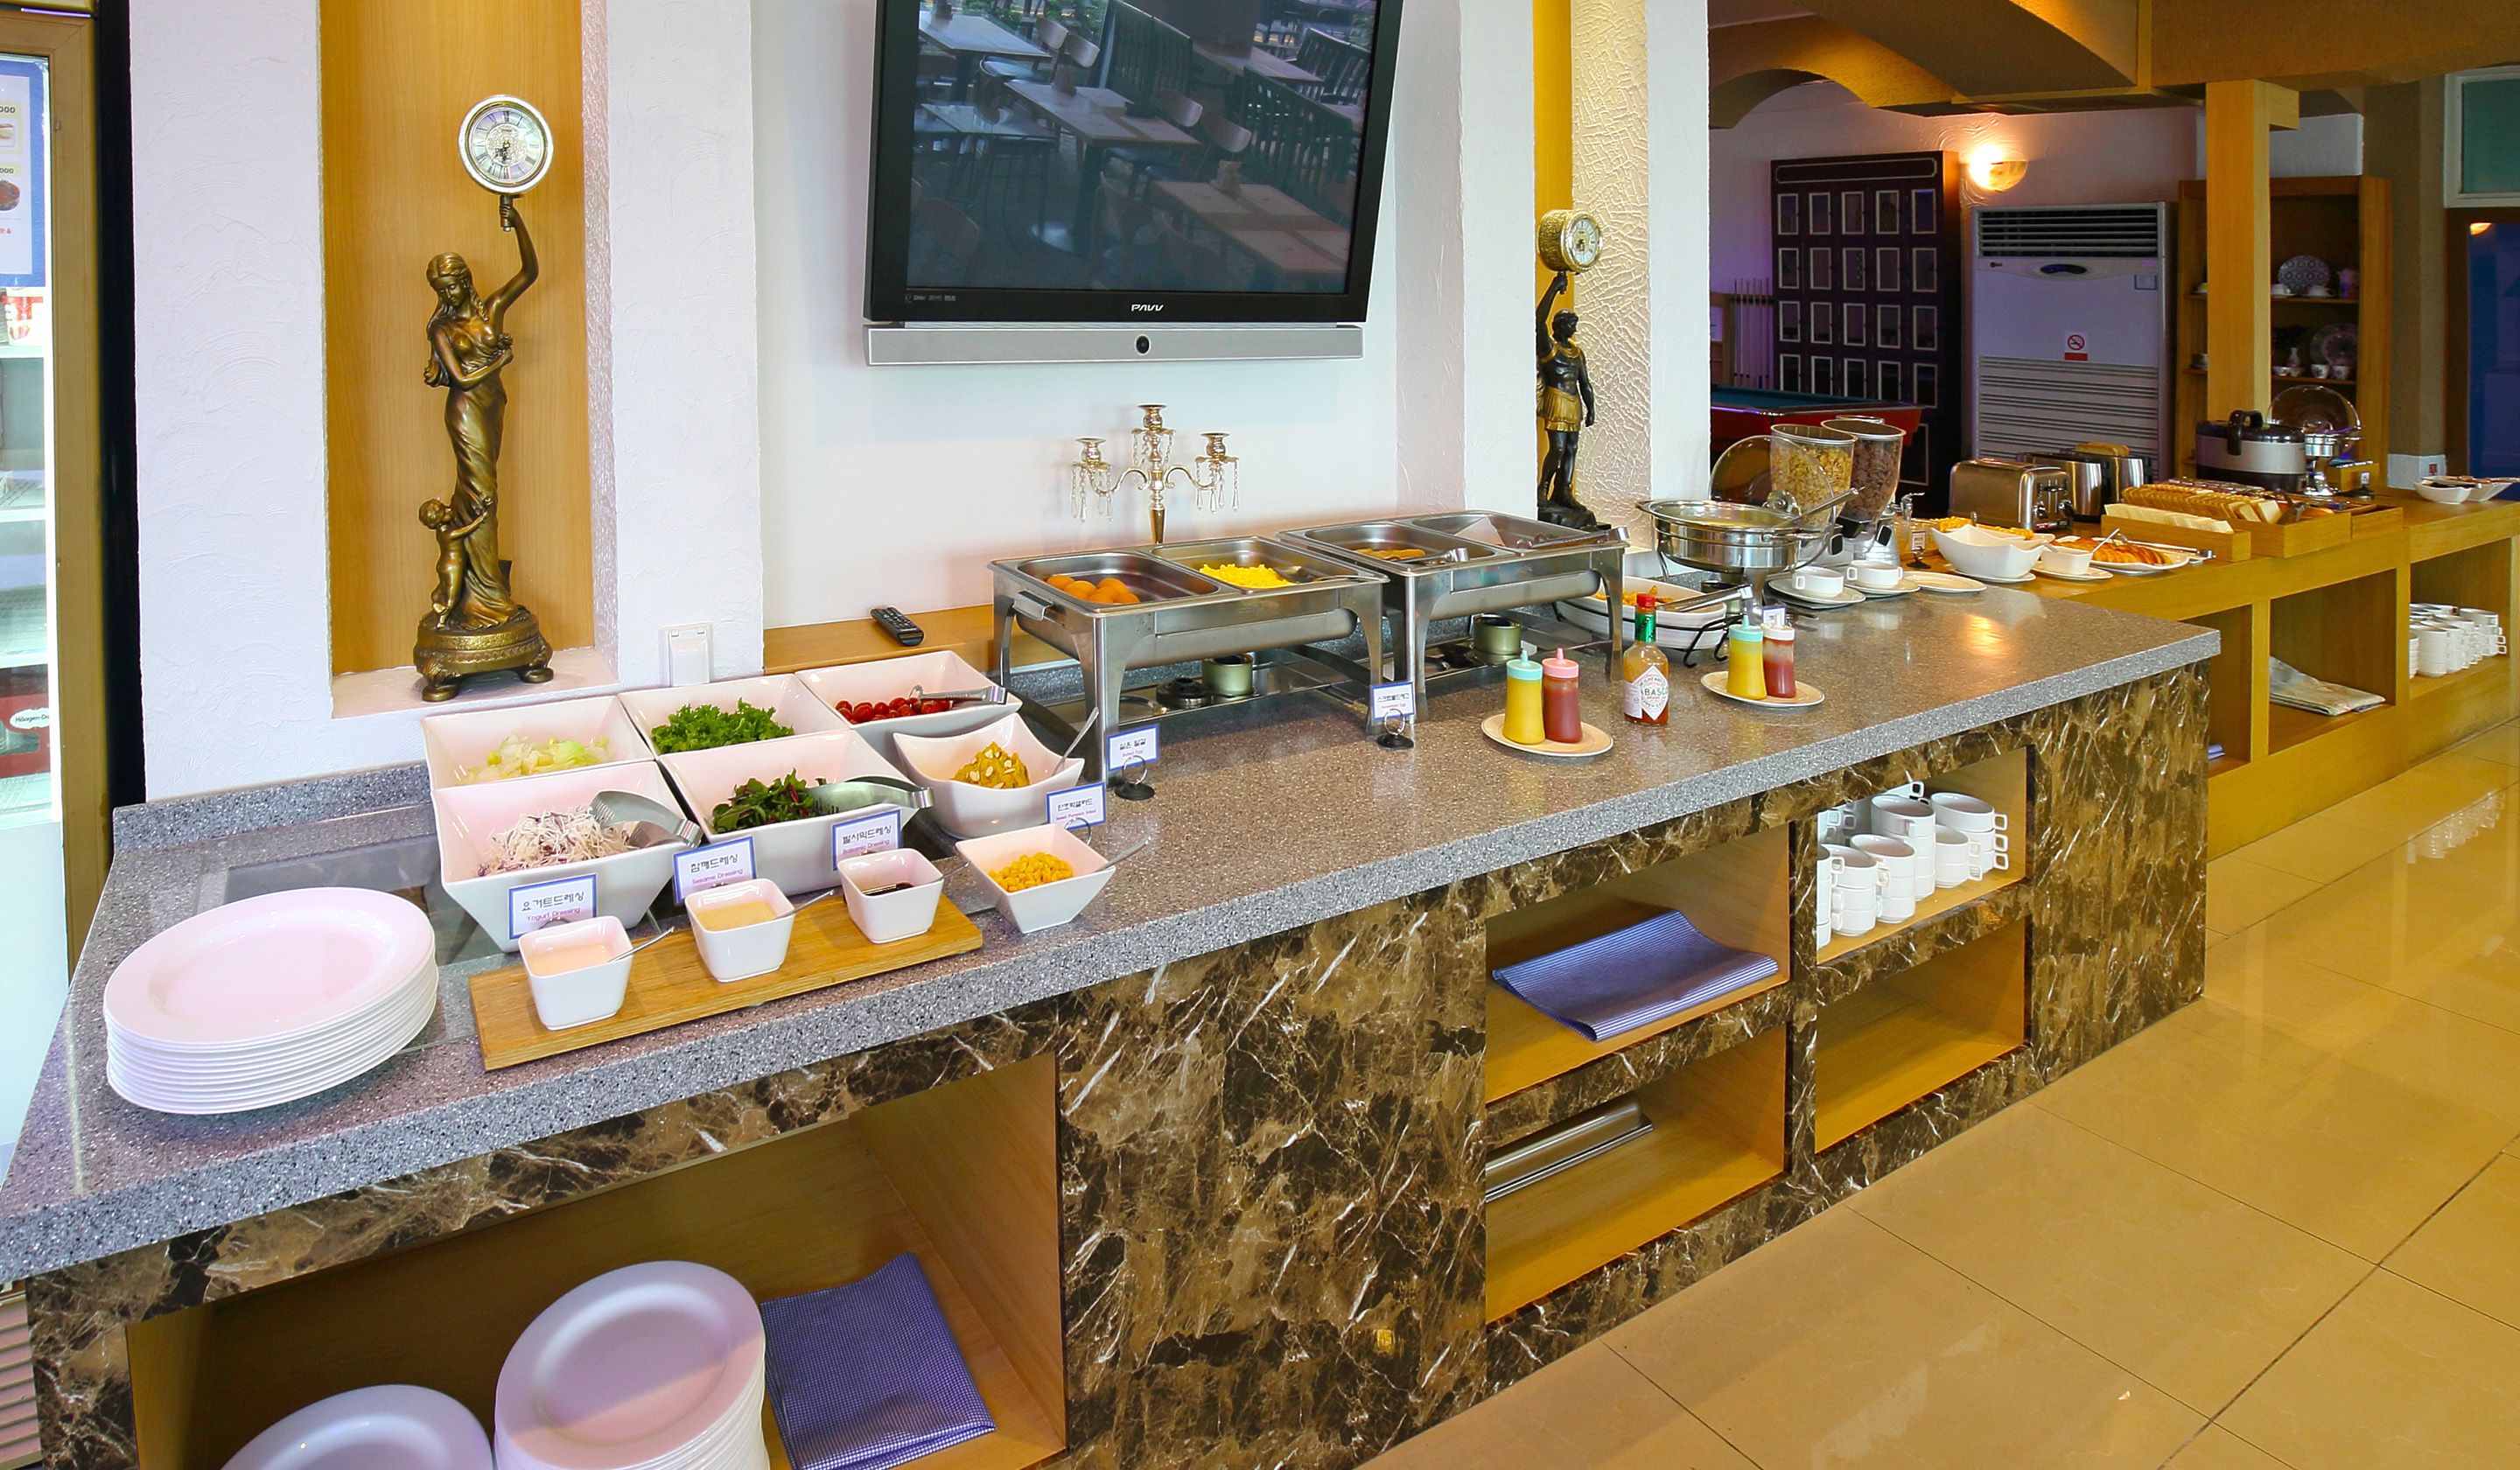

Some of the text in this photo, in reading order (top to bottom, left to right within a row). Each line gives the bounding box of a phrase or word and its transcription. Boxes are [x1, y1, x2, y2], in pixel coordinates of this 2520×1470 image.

[868, 839, 890, 849] Dressing
[690, 853, 738, 873] 참깨드레싱
[692, 868, 743, 885] Sesame Dressing
[522, 891, 584, 912] 요거트드레싱
[527, 907, 580, 922] Yogurt Dressing
